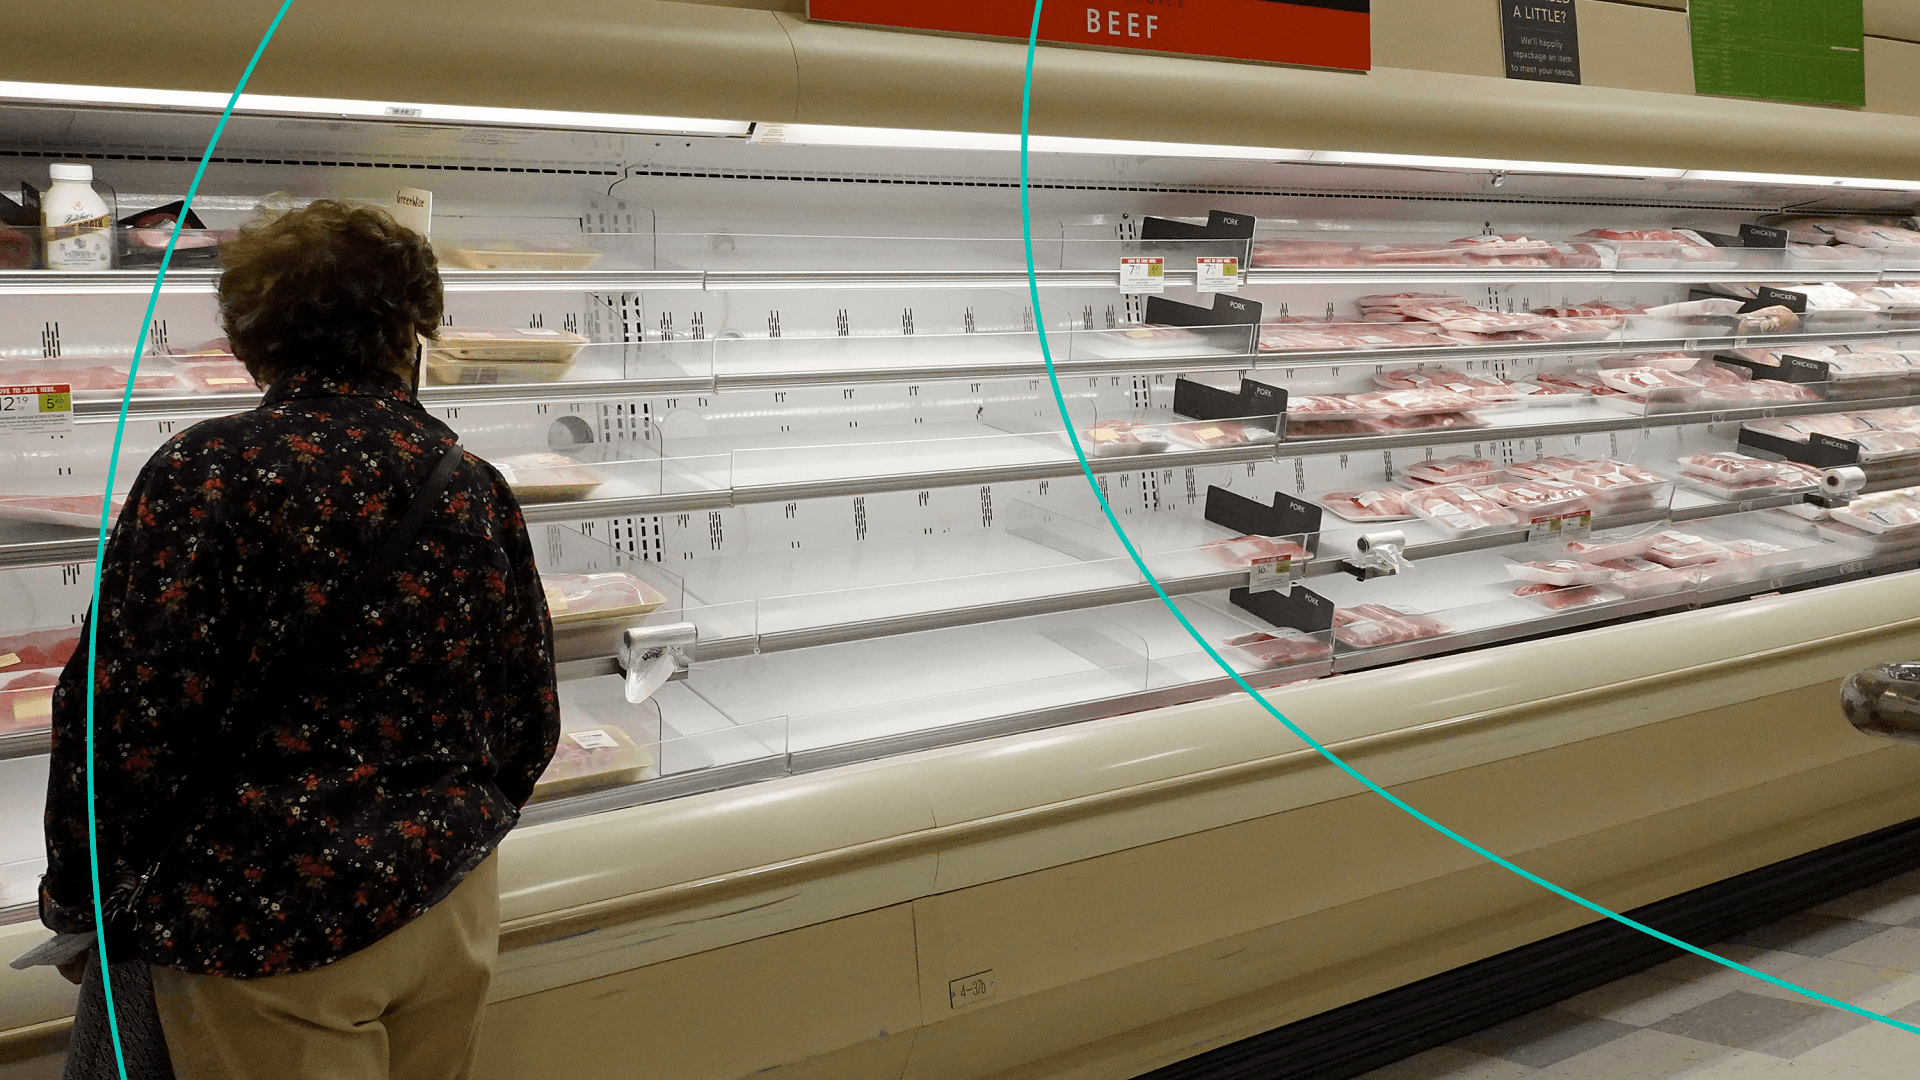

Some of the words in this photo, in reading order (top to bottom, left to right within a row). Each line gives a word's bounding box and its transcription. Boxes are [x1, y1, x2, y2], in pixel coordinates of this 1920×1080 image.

[1513, 5, 1521, 18] A
[1525, 7, 1567, 23] LITTLE?
[1087, 8, 1158, 39] BEEF
[1521, 36, 1537, 46] We'll
[1539, 38, 1563, 50] happily
[1513, 51, 1546, 62] repackage
[1558, 55, 1573, 63] item
[1520, 65, 1536, 73] meet
[1539, 67, 1552, 76] your
[1223, 217, 1239, 226] PORK
[1750, 228, 1777, 238] CHICKEN
[1770, 291, 1797, 301] CHICKEN
[1229, 300, 1246, 311] PORK
[1791, 359, 1819, 370] CHICKEN
[1256, 387, 1272, 398] PORK
[1820, 438, 1848, 450] CHICKEN
[1290, 501, 1306, 513] PORK
[1304, 593, 1319, 606] PORK
